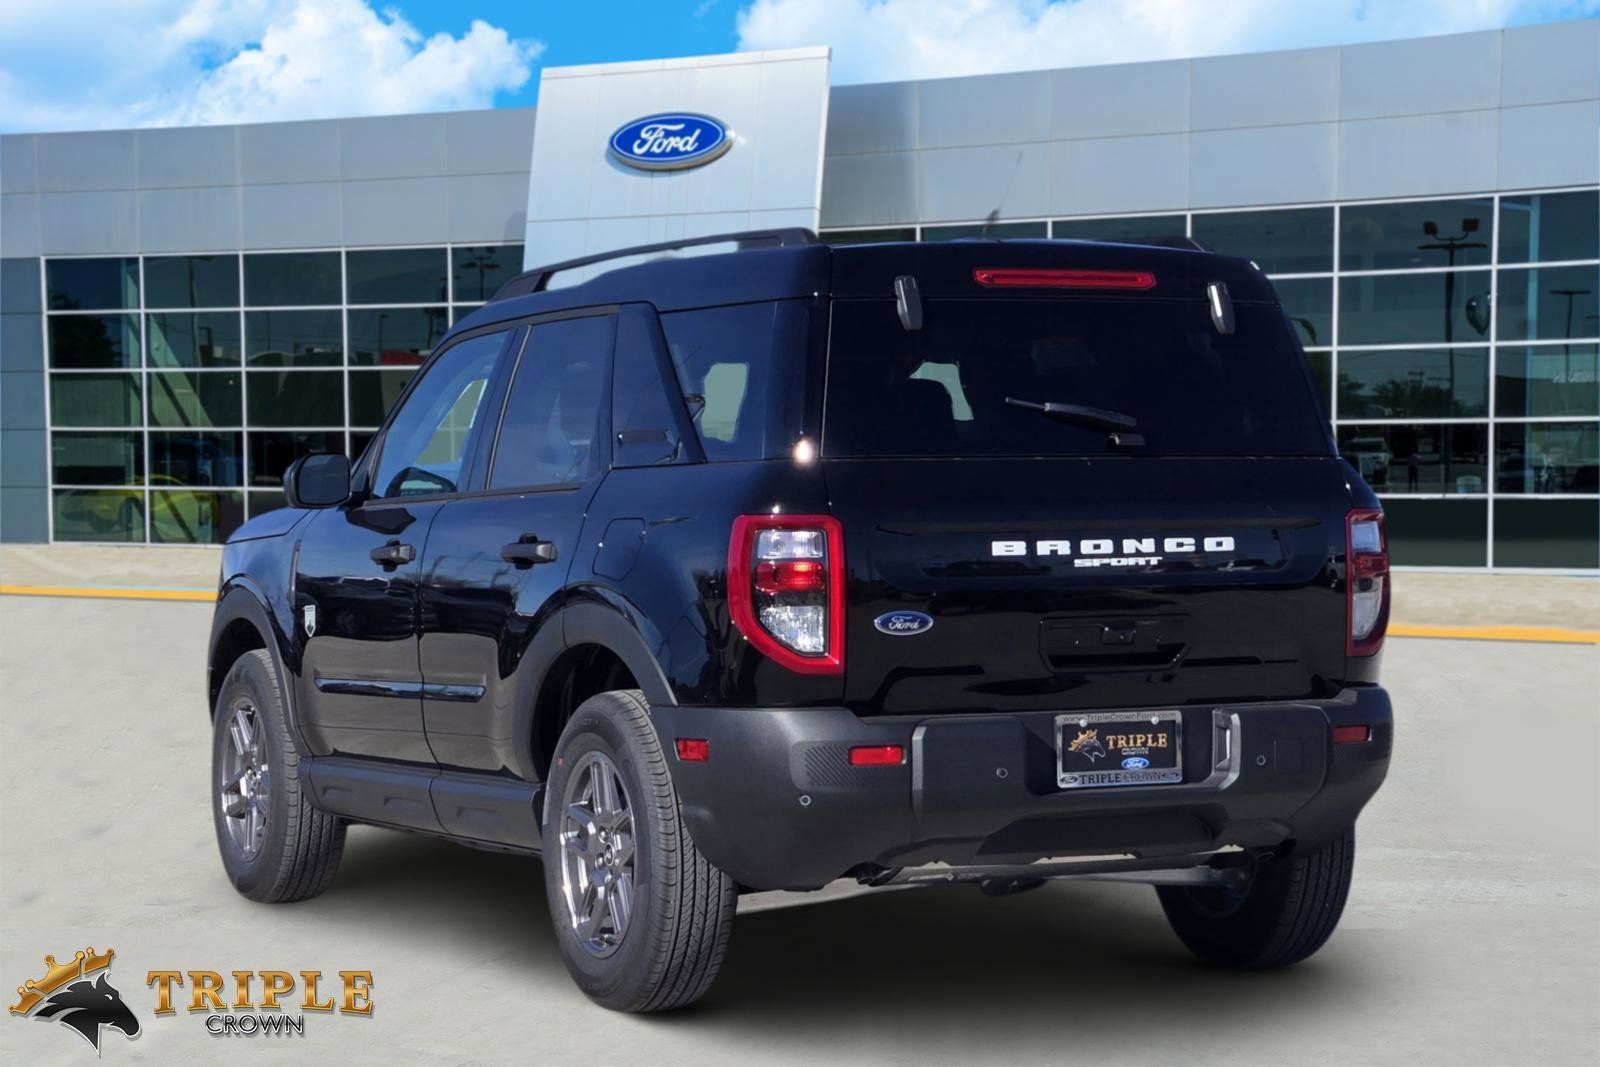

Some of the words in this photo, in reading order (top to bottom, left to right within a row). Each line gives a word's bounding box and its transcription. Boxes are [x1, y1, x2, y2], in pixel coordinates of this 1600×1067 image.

[633, 124, 701, 155] Ford
[992, 537, 1235, 556] BRONCO
[1074, 557, 1162, 567] SPORT
[889, 616, 920, 630] Ford
[1063, 711, 1177, 722] www.TripleCrownFordcom
[1106, 733, 1168, 749] TRIPLE
[1080, 774, 1121, 784] TRIPLE
